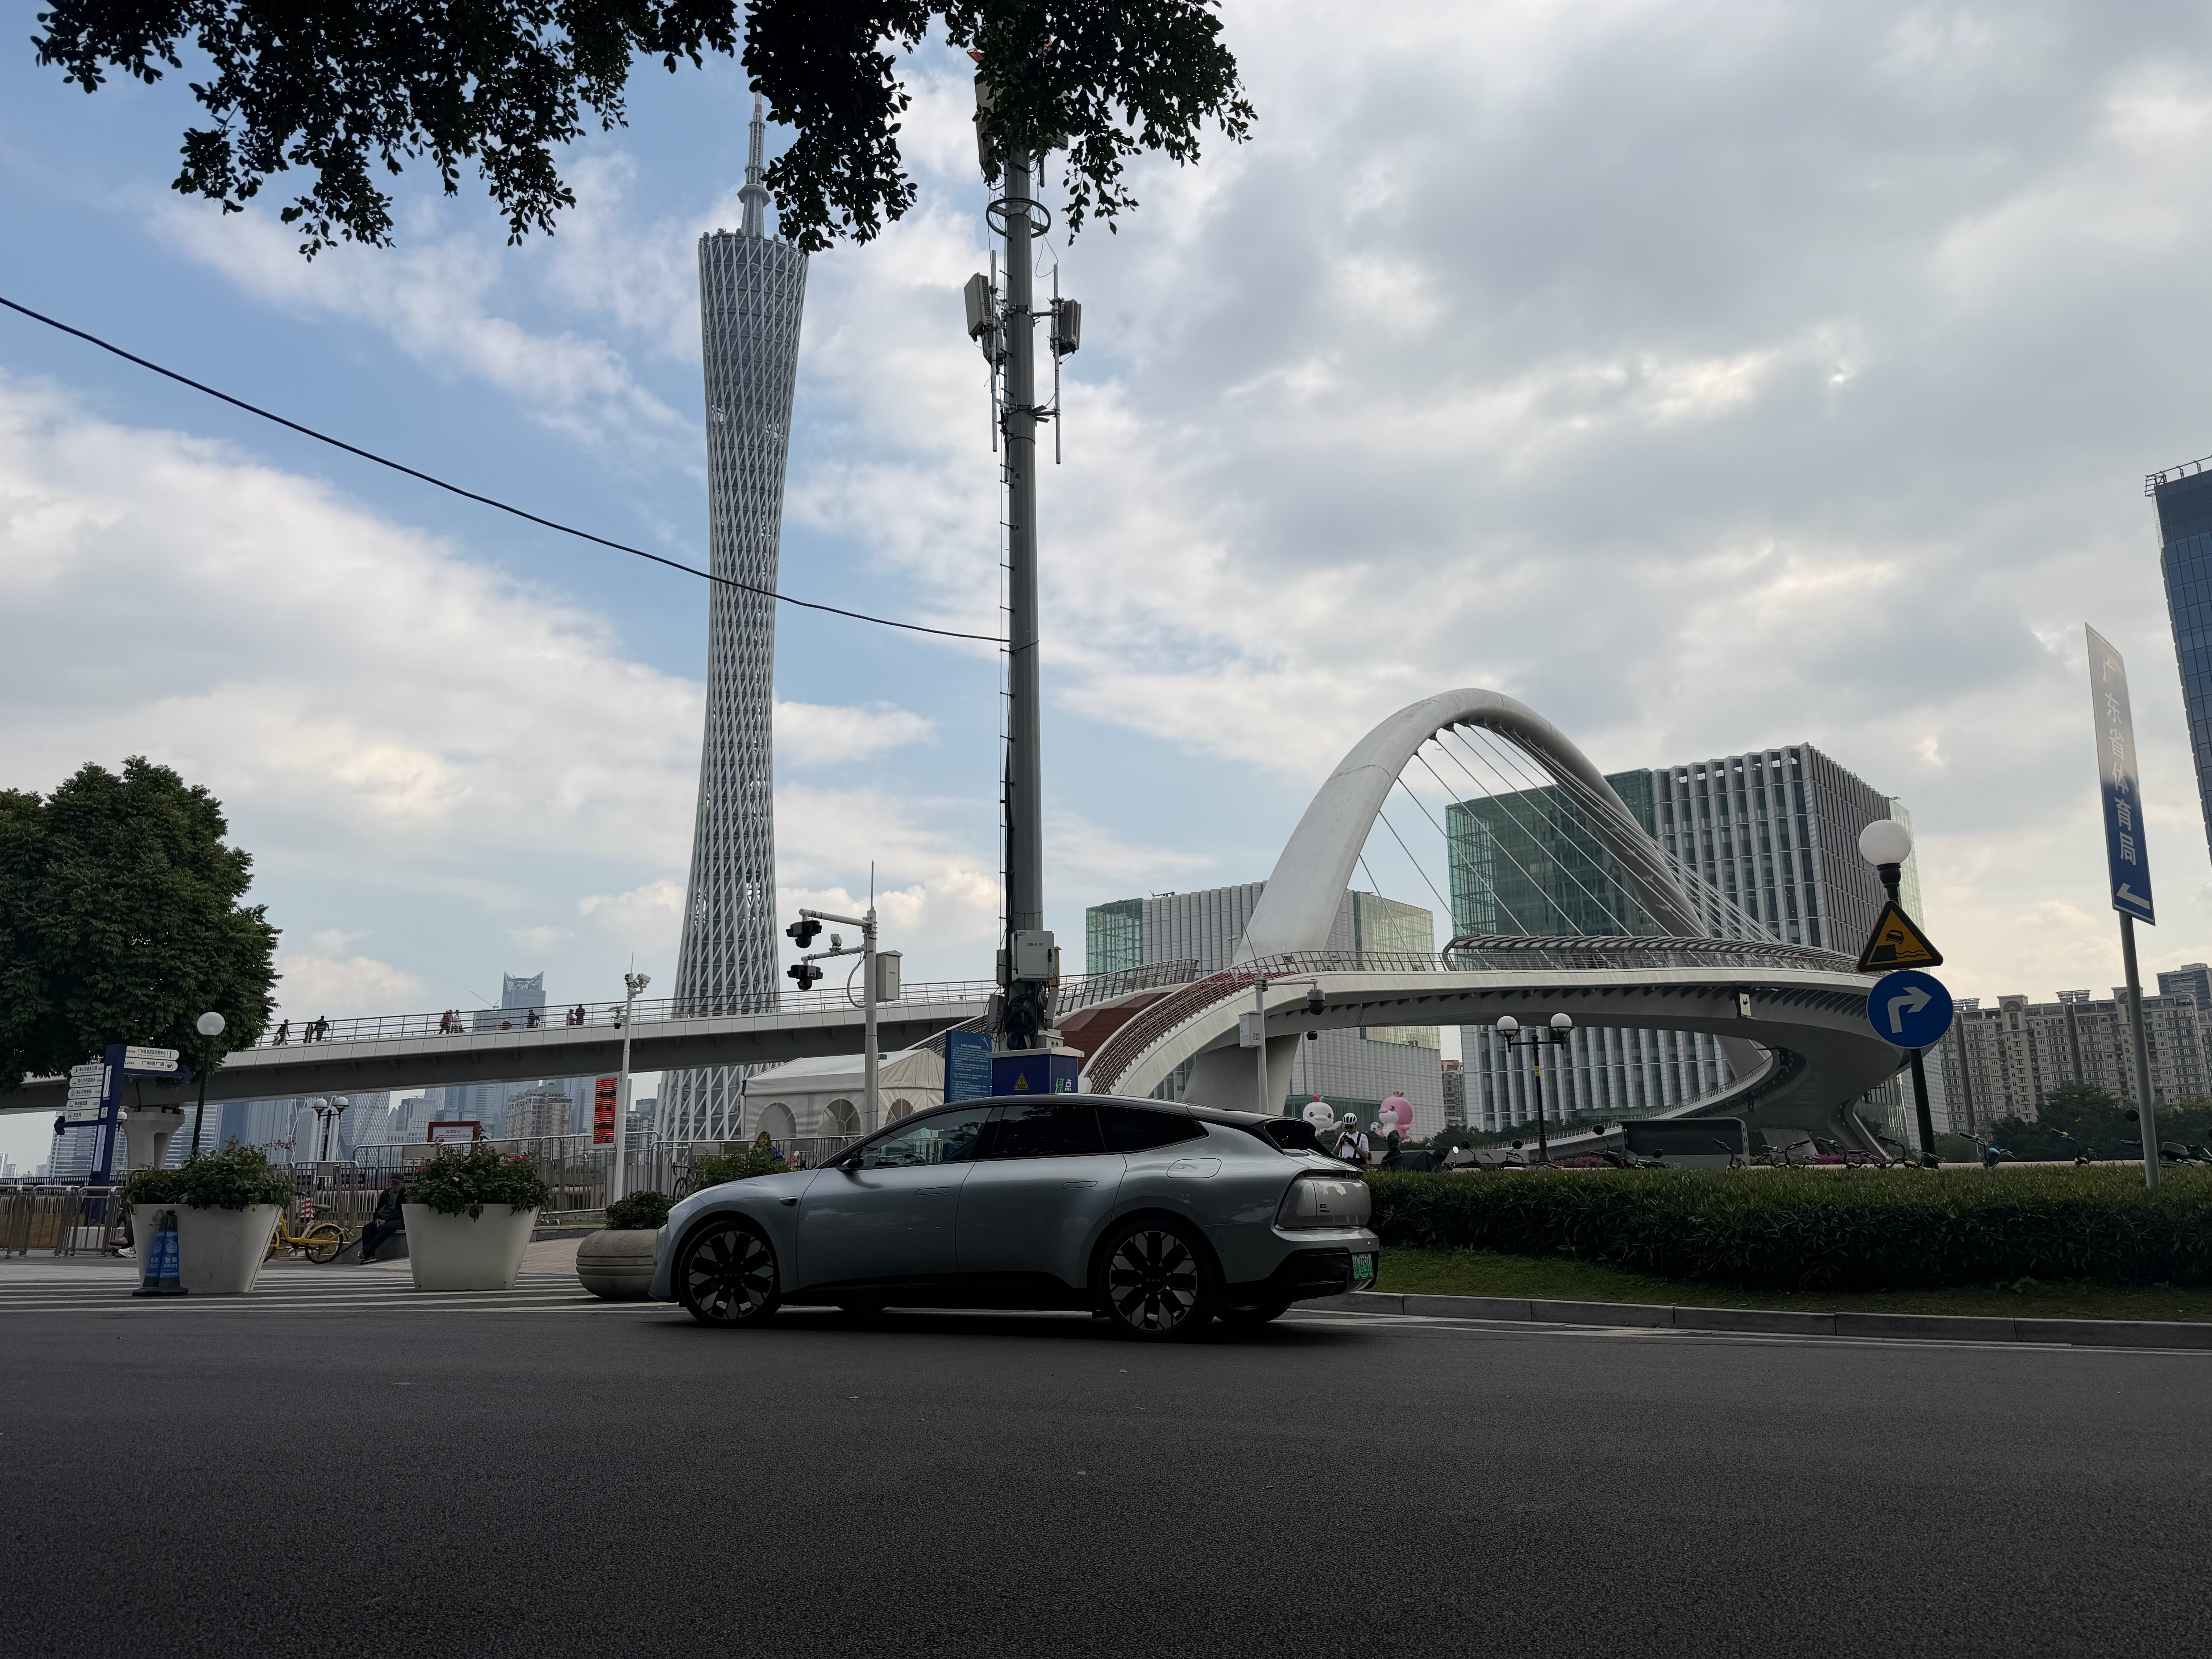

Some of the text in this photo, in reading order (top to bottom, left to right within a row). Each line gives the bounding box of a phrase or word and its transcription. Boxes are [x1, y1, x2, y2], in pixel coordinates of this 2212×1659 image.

[2102, 658, 2136, 866] 广东省体育局
